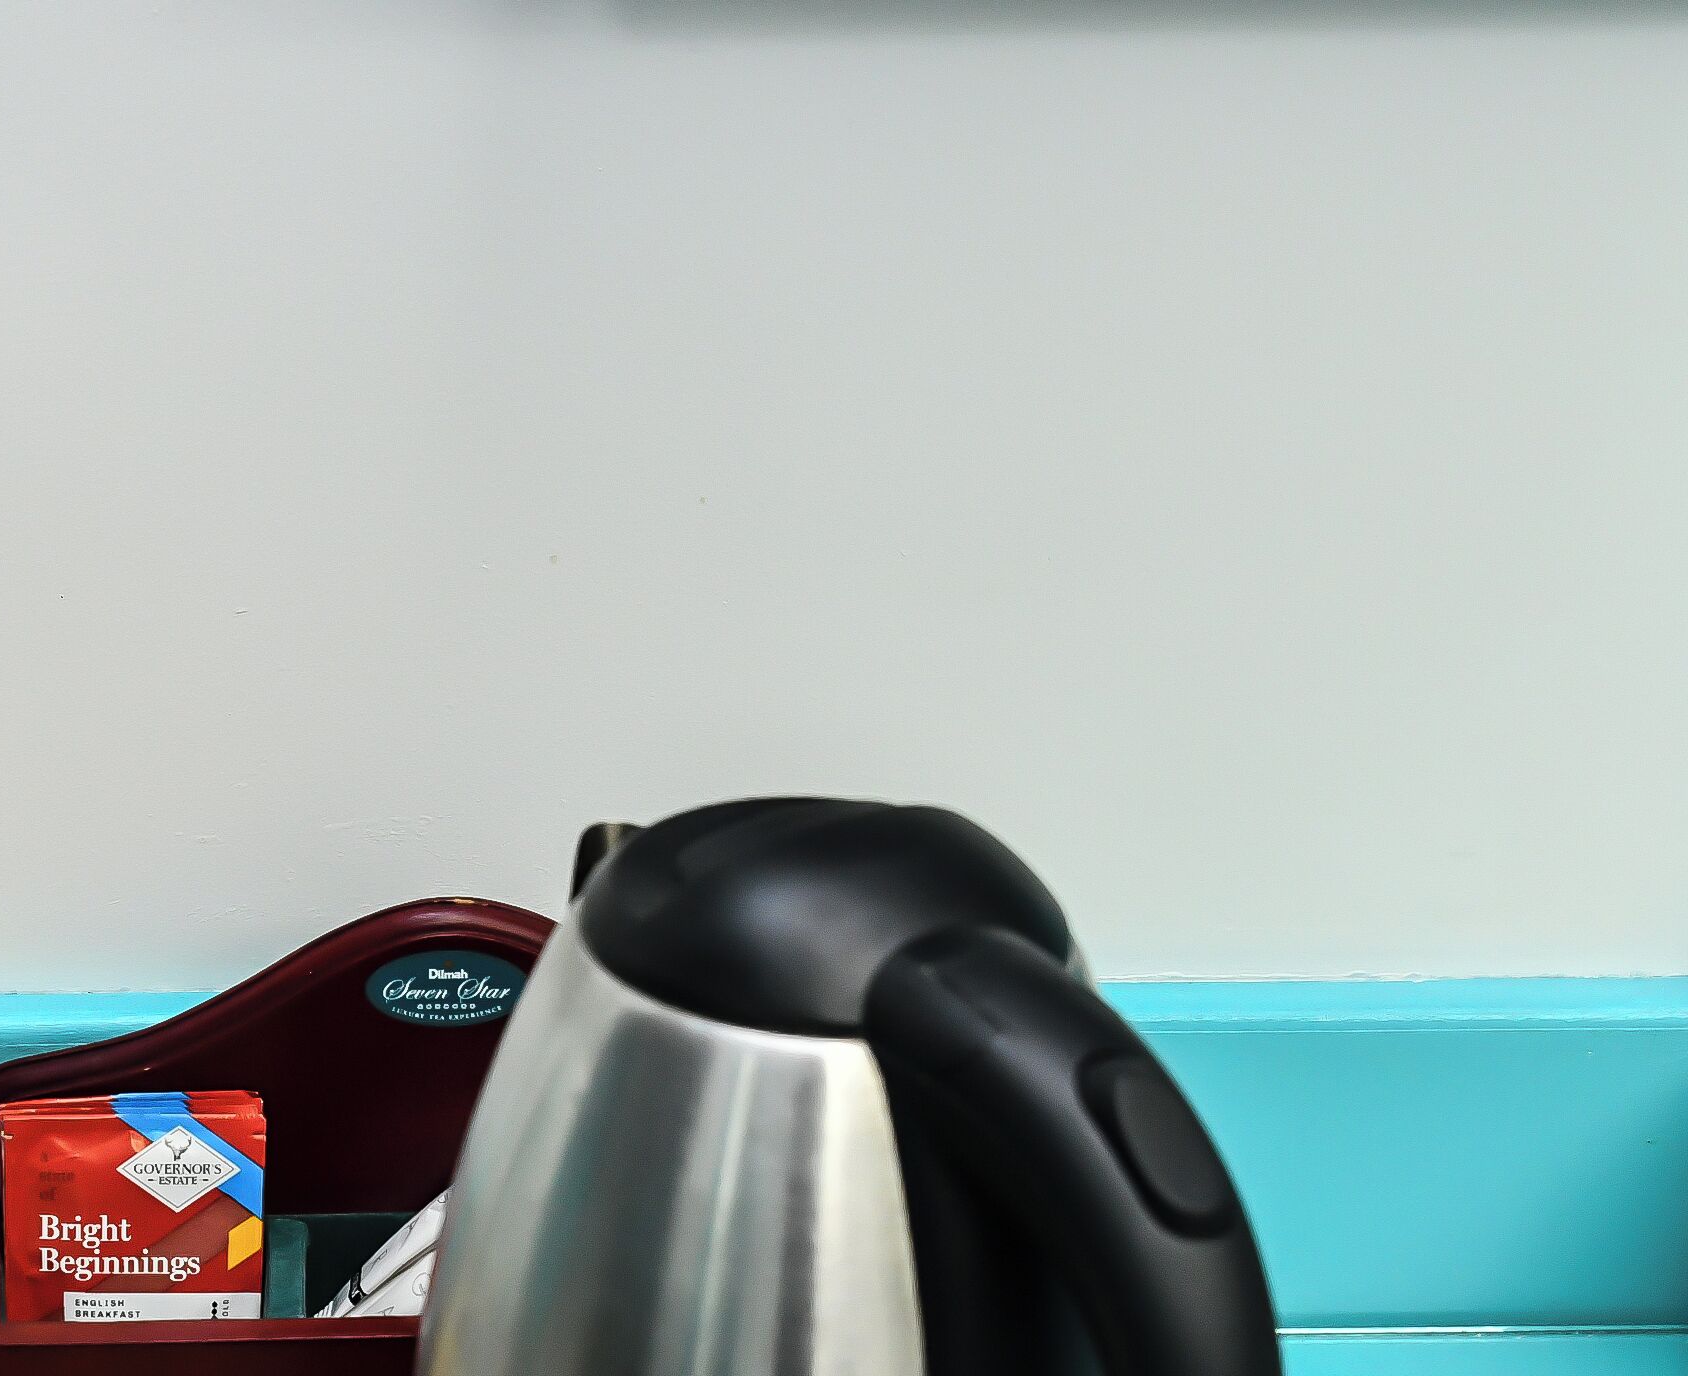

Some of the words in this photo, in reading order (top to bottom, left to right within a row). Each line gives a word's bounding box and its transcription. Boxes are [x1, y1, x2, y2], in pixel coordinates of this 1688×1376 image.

[428, 968, 469, 980] Dilmah
[383, 977, 448, 1003] Seven
[457, 975, 511, 1003] Star
[448, 1005, 503, 1021] EXPERIENCE
[133, 1163, 222, 1176] GOVERNOR'S
[158, 1176, 198, 1186] ESTATE
[39, 1215, 131, 1248] Bright
[39, 1247, 201, 1282] Beginnings
[75, 1298, 125, 1308] ENGLISH
[75, 1310, 141, 1319] BREAKFAST
